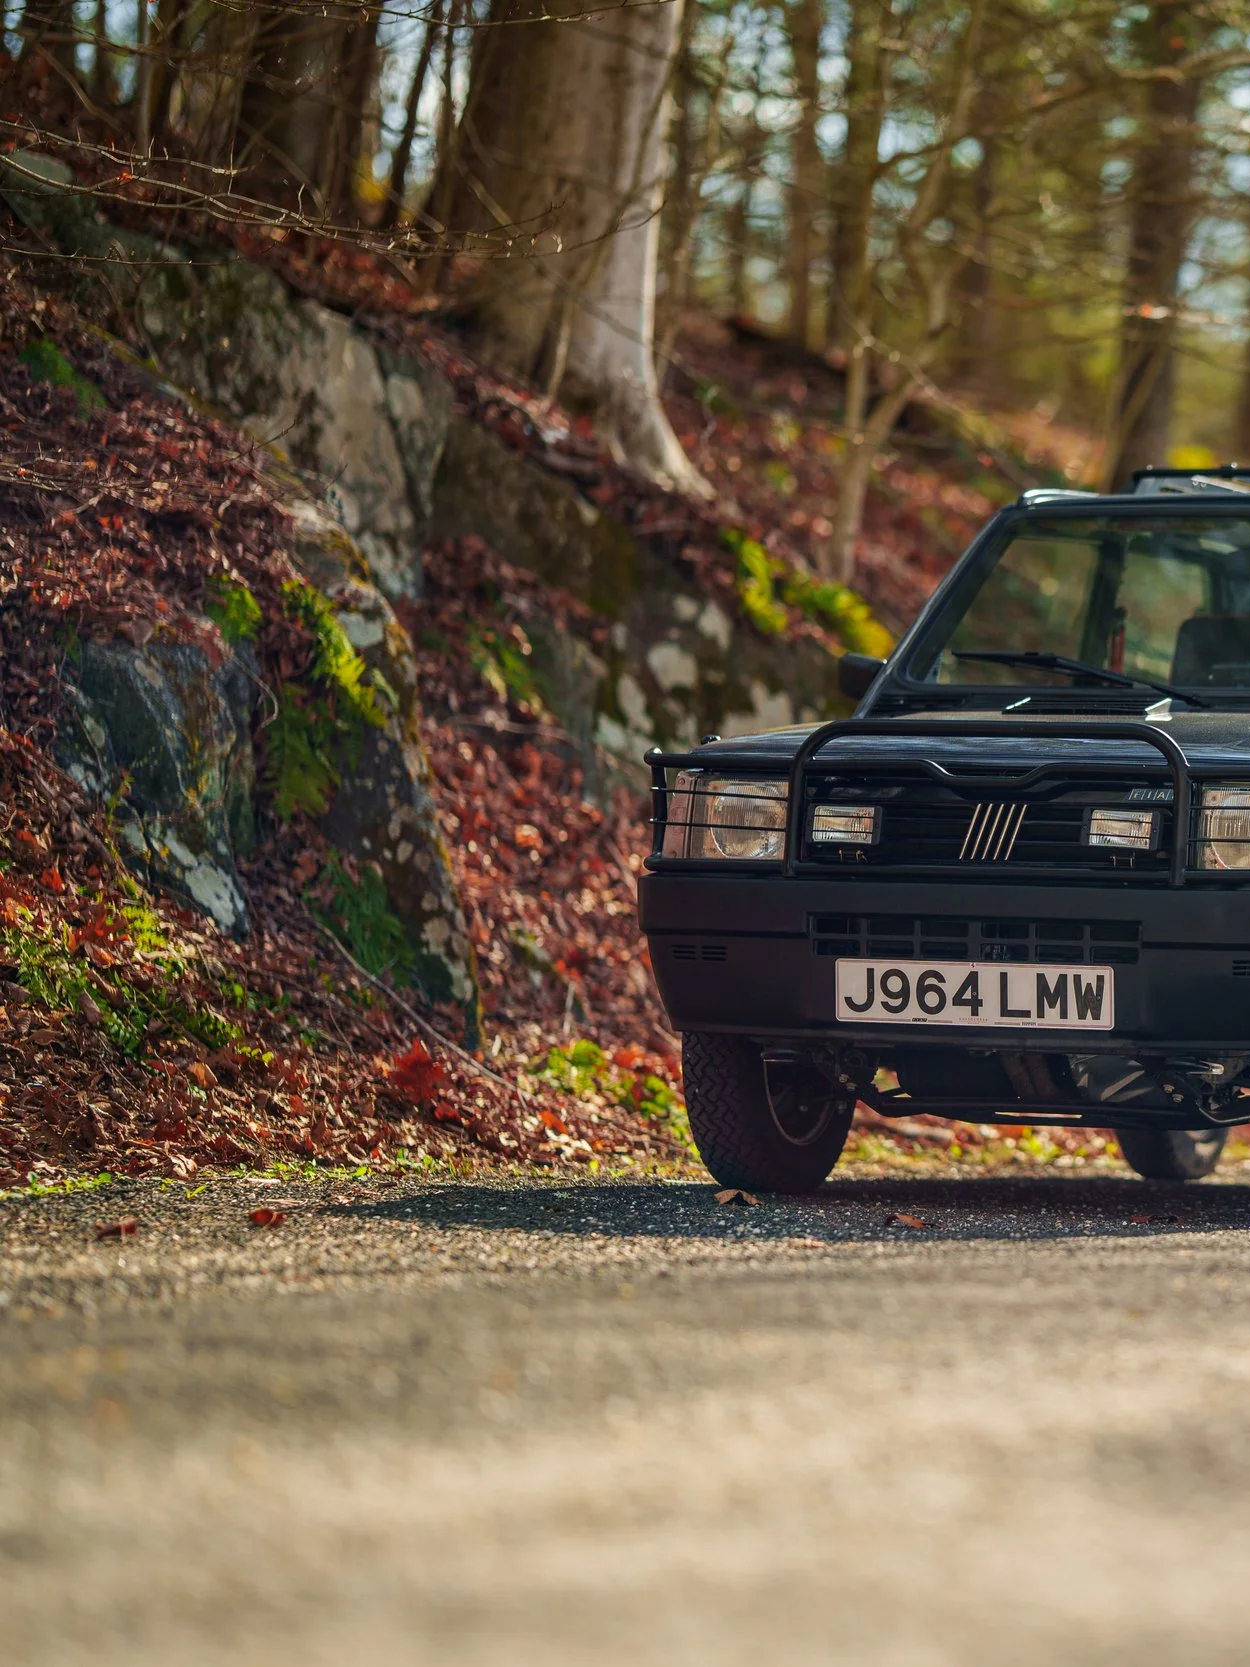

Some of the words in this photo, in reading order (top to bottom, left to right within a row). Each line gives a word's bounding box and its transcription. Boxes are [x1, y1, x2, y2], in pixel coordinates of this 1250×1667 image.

[1133, 789, 1174, 800] FIA
[844, 967, 983, 1017] J964
[999, 971, 1105, 1021] LMW
